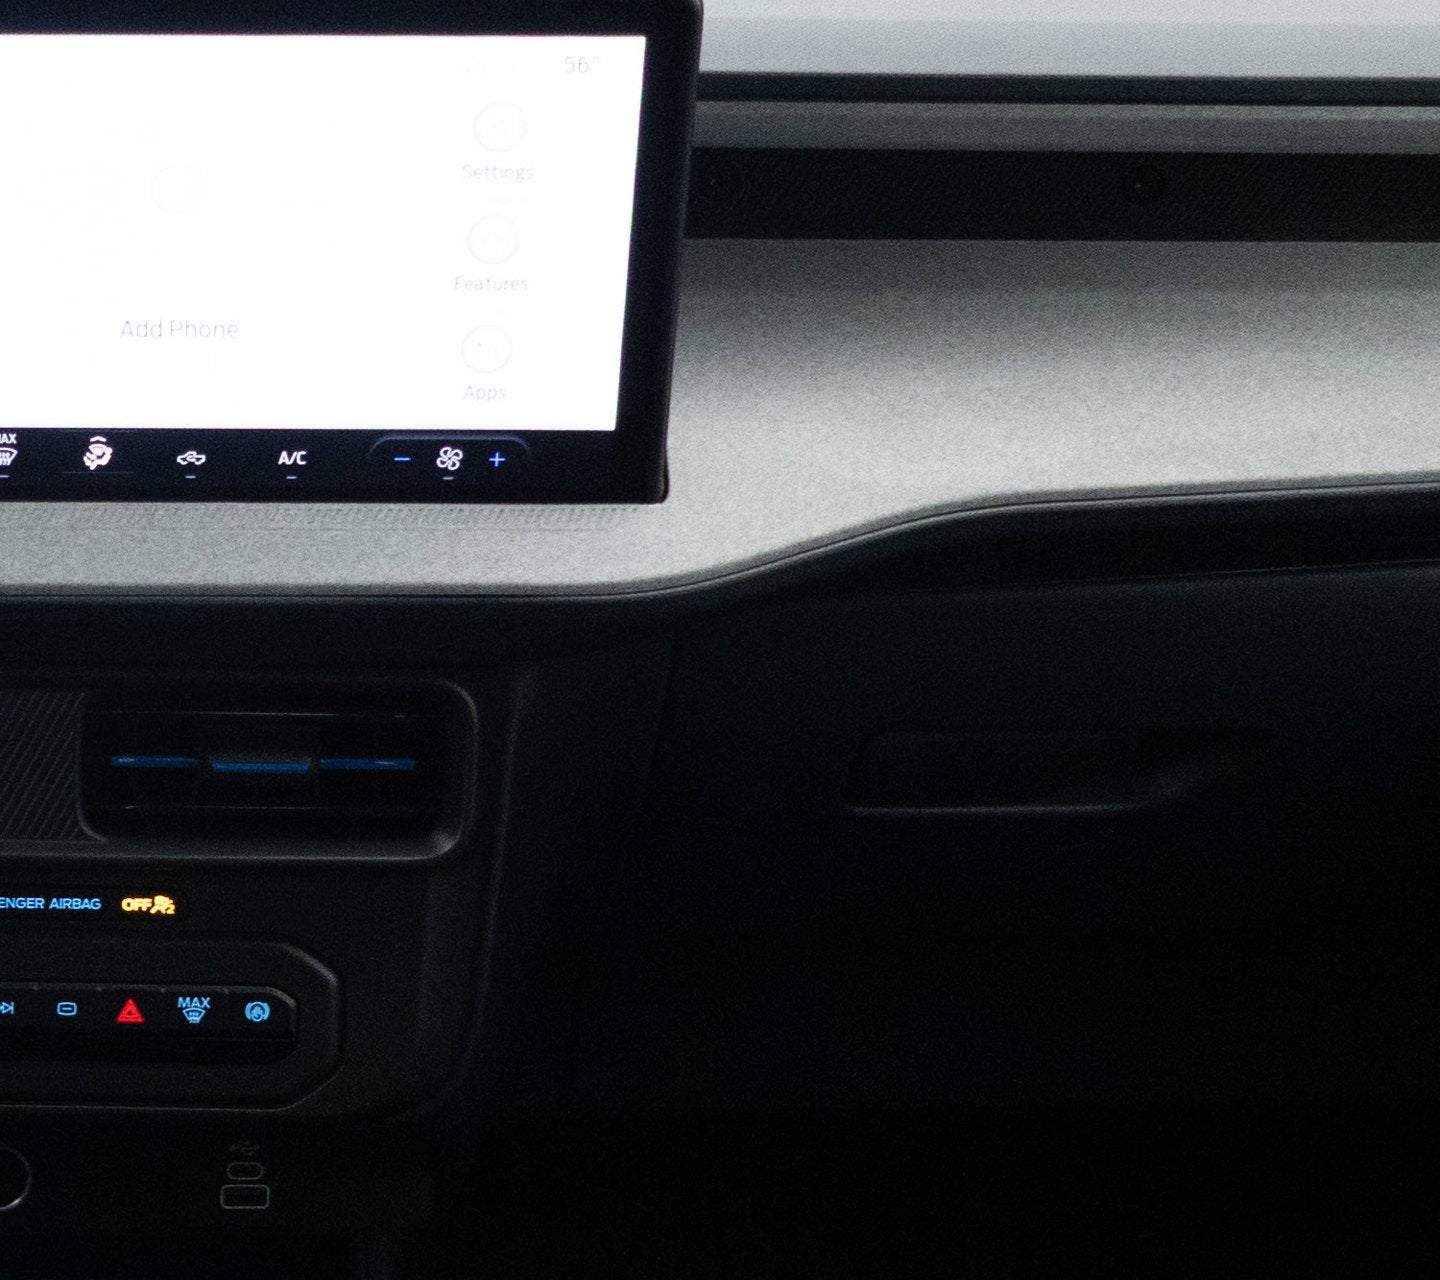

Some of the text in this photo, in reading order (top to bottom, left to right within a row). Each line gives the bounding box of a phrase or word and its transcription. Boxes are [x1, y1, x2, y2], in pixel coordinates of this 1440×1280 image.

[462, 164, 534, 183] Settings
[453, 275, 529, 292] Features
[120, 319, 239, 339] Add Phone
[463, 384, 507, 401] Apps
[278, 451, 307, 465] A/C
[48, 897, 102, 911] AIRBAG
[121, 897, 152, 912] OFF
[177, 996, 211, 1009] MAX
